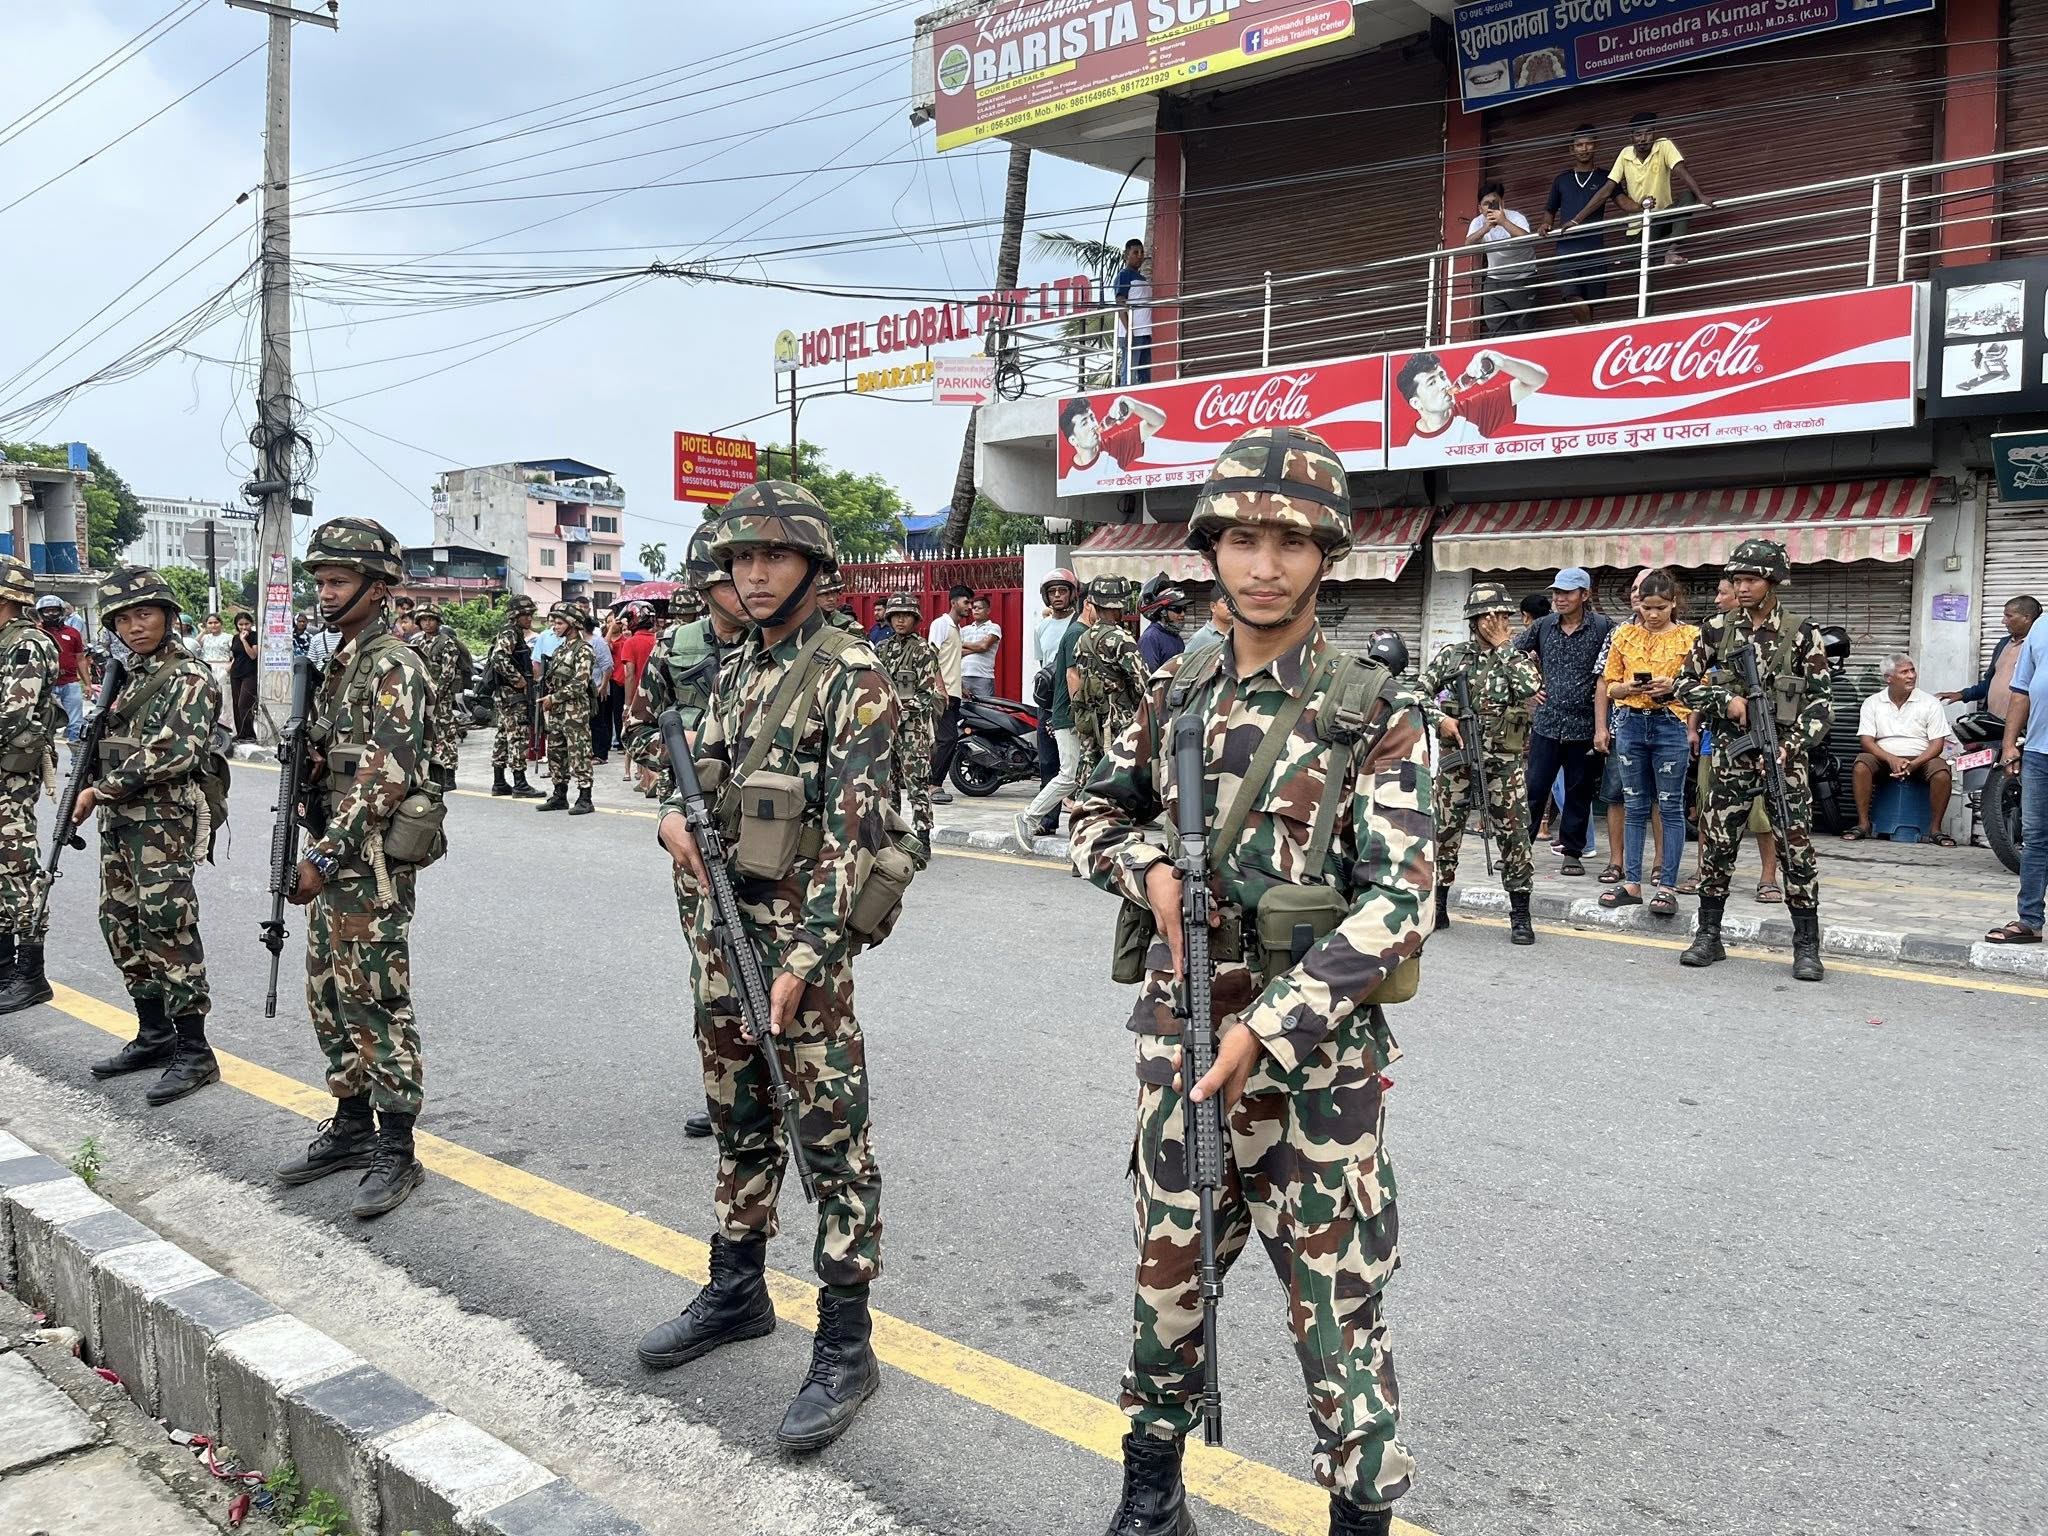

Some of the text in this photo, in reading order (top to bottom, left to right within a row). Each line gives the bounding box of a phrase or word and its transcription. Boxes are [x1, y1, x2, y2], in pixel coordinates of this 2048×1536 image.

[974, 1, 1138, 90] BARISTA
[1263, 11, 1331, 35] Kathmandu Bakery
[1263, 19, 1346, 47] Barista Training Center
[1460, 7, 1549, 60] शुभकामना
[1585, 50, 1634, 70] Consultant
[1636, 36, 1694, 59] Orthodontist
[1702, 28, 1731, 43] B.D.S.
[1765, 14, 1797, 28] M.D.S.
[1800, 6, 1828, 22] (K.U.)
[1598, 35, 1623, 53] Dr.
[1629, 15, 1701, 46] Jitendra
[1706, 0, 1768, 27] Kumar
[975, 125, 985, 136] Tel
[1034, 107, 1053, 119] Mob.
[1055, 101, 1068, 112] No:
[1120, 71, 1170, 93] 9817221929
[979, 72, 1046, 97] COURSE DETAILS
[801, 321, 873, 368] HOTEL
[876, 303, 971, 352] GLOBAL
[1592, 316, 1773, 390] Coca-Cola
[856, 362, 934, 393] BHARATP
[936, 377, 992, 389] PARKING
[1194, 371, 1318, 430] Coca-Cola
[681, 435, 754, 460] HOTEL GLOBAL
[1494, 438, 1546, 455] ढकाल
[1586, 431, 1618, 447] एण्ड
[1623, 427, 1657, 447] जुस
[1663, 422, 1712, 441] पसल
